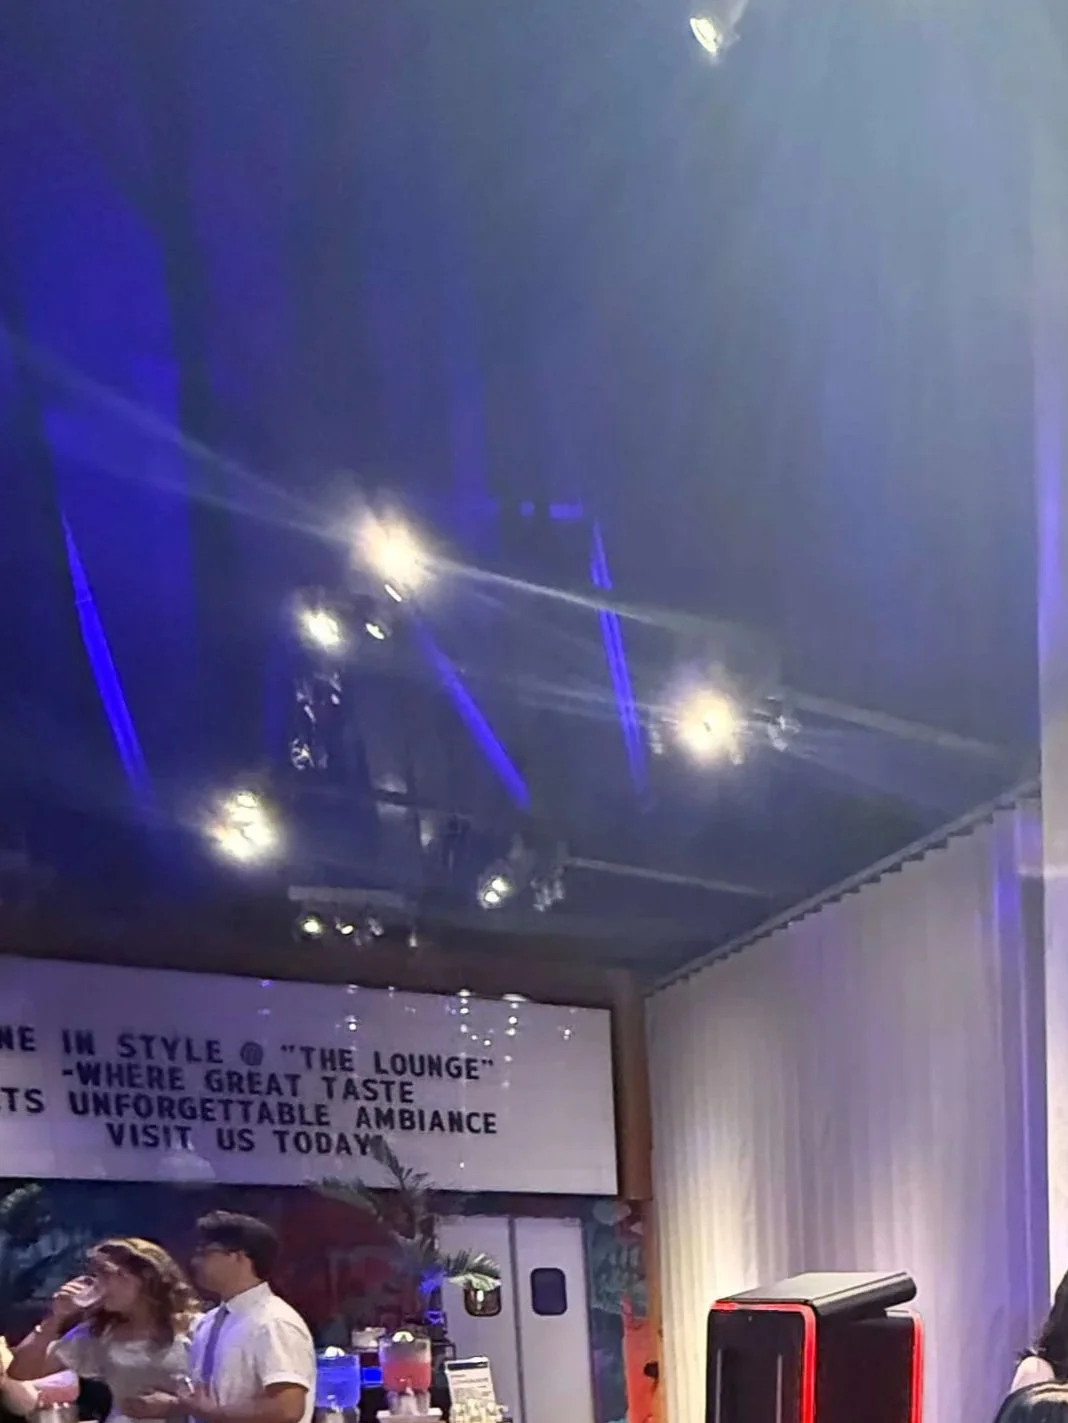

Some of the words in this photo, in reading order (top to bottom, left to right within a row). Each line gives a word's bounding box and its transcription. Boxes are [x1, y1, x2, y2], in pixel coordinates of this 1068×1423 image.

[62, 1028, 95, 1055] IN
[118, 1033, 223, 1064] STYLE
[62, 1061, 185, 1090] -WHERE
[204, 1069, 301, 1097] GREAT
[322, 1076, 414, 1104] TASTE
[0, 1087, 44, 1114] TS
[68, 1091, 330, 1127] UNFORGETTABLE
[356, 1106, 497, 1134] AMBIANCE
[106, 1122, 192, 1148] VISIT
[216, 1128, 255, 1151] US
